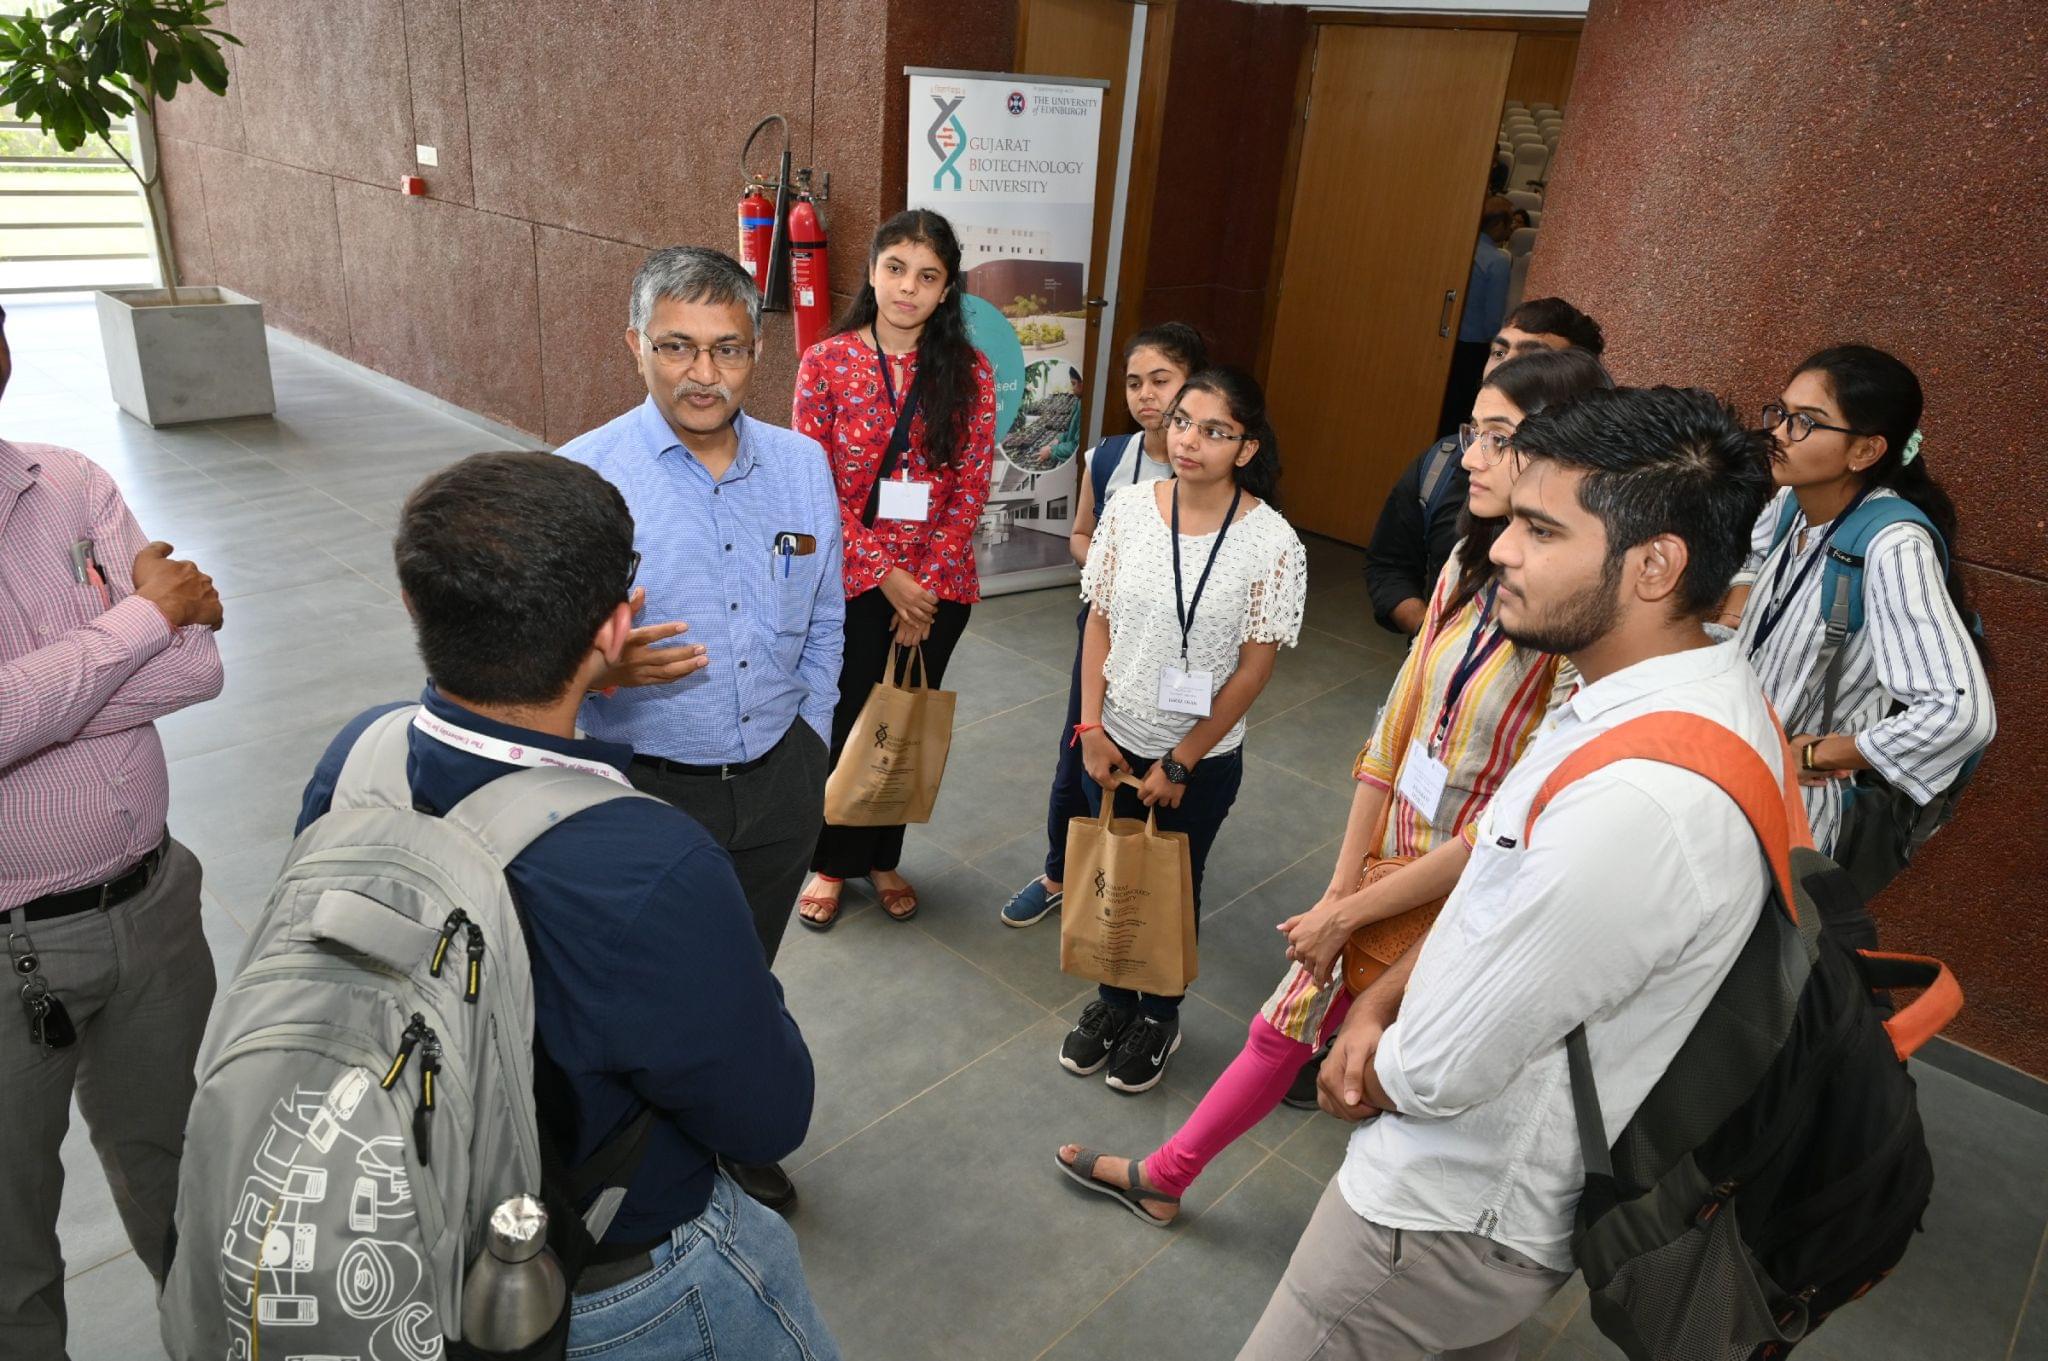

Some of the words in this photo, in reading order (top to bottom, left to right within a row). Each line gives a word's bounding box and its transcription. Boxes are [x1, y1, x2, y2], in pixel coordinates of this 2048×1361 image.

[1034, 96, 1049, 105] THE
[1052, 97, 1098, 108] UNIVERSITY
[1041, 107, 1087, 116] EDINBURGH
[969, 137, 1032, 153] GUJARAT
[969, 159, 1084, 175] BIOTECHNOLOGY
[969, 179, 1048, 194] UNIVERSITY
